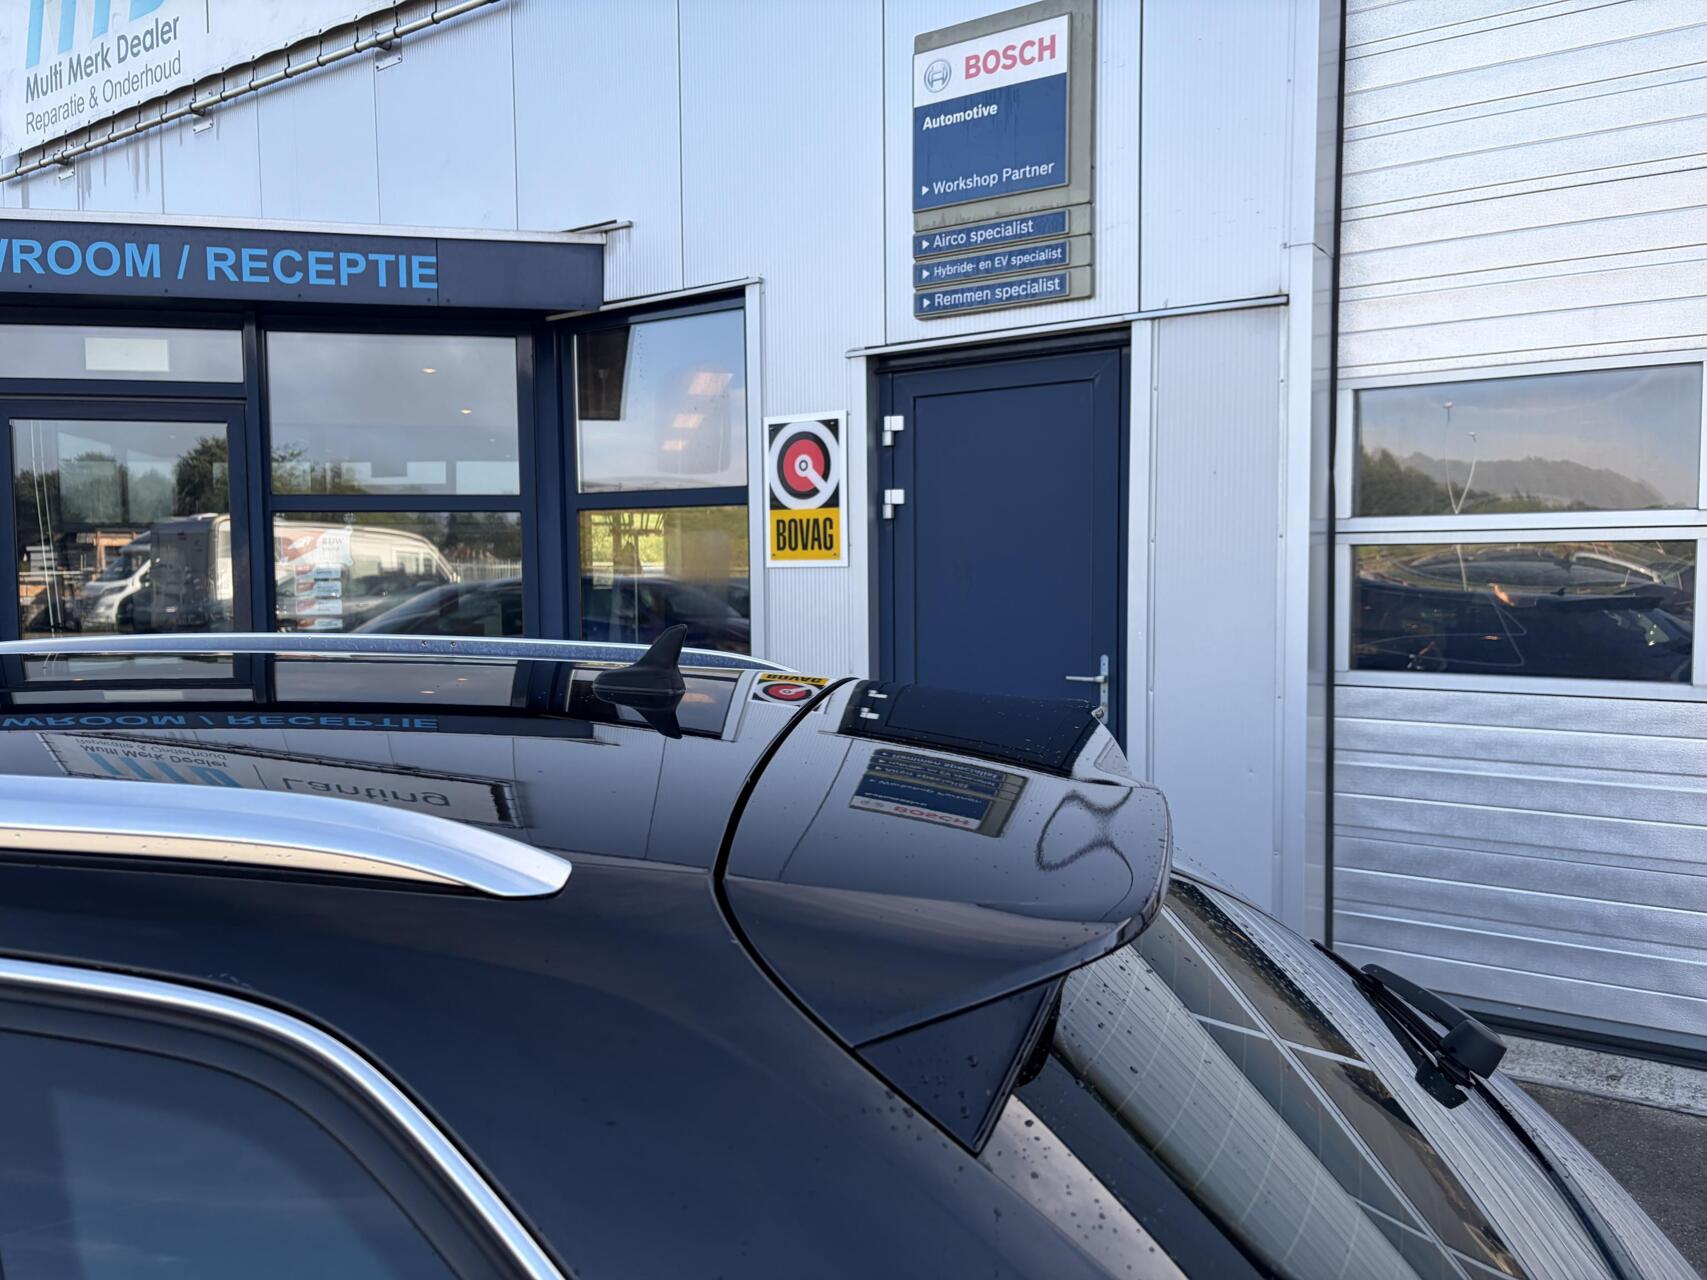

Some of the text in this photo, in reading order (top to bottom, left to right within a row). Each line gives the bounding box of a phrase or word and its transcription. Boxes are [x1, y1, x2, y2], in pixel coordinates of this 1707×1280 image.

[25, 61, 63, 104] Multi
[68, 42, 112, 86] Merk
[116, 16, 180, 65] Dealer
[964, 34, 1057, 80] BOSCH
[26, 50, 182, 135] Reparatie & Onderhoud
[922, 104, 998, 131] Automotive
[933, 162, 1056, 195] Workshop Partner
[933, 219, 1034, 249] Airco specialist
[206, 246, 438, 290] RECEPTIE
[979, 259, 992, 271] en
[994, 255, 1009, 268] EV
[1011, 247, 1062, 266] specialist
[934, 277, 1061, 307] Remmen specialist
[776, 516, 834, 553] BOVAG
